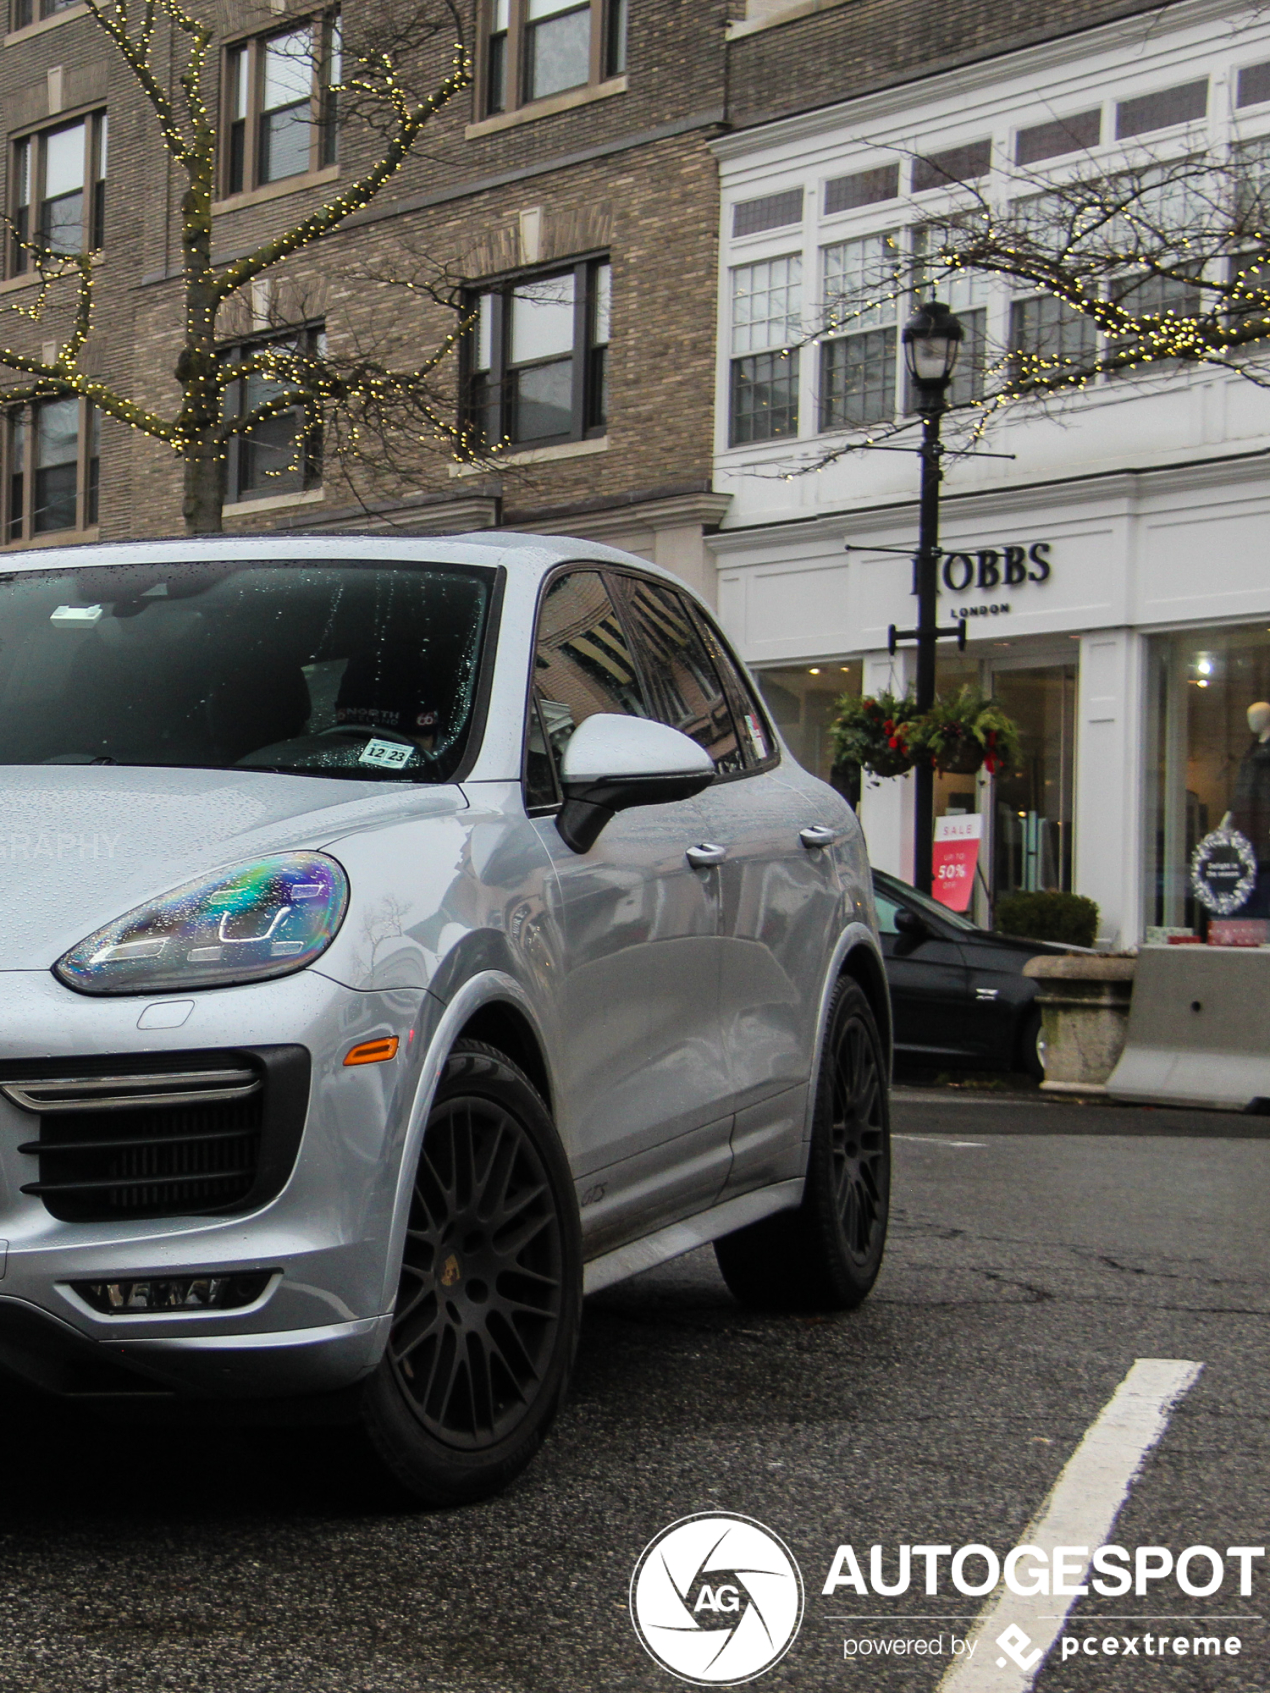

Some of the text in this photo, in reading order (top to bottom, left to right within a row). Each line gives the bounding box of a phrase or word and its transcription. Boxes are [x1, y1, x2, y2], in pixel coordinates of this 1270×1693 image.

[950, 603, 1010, 618] LONDON
[346, 708, 400, 719] NORTH
[367, 747, 385, 758] 12
[388, 751, 405, 762] 23
[943, 825, 972, 836] SALE
[938, 864, 966, 879] 50%
